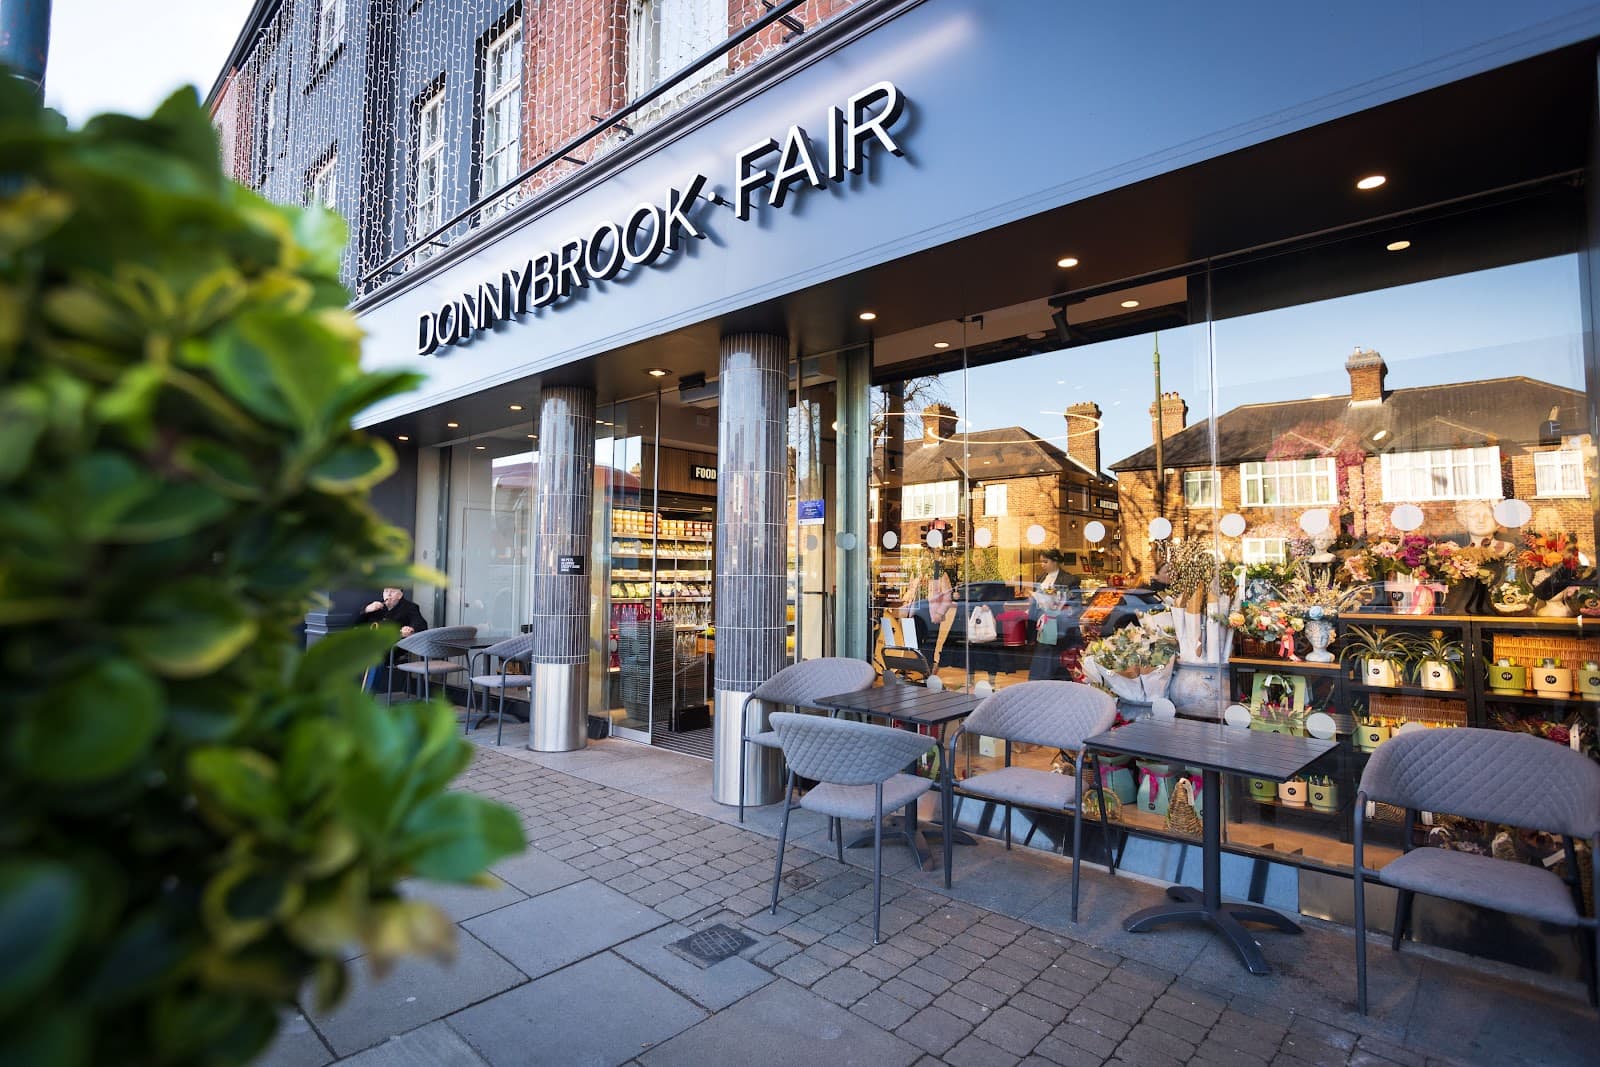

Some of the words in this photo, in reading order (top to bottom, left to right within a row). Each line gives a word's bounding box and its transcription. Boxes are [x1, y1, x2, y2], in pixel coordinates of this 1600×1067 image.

[416, 174, 707, 356] DONNYBROOK
[735, 81, 905, 221] FAIR
[695, 466, 717, 480] FOOD
